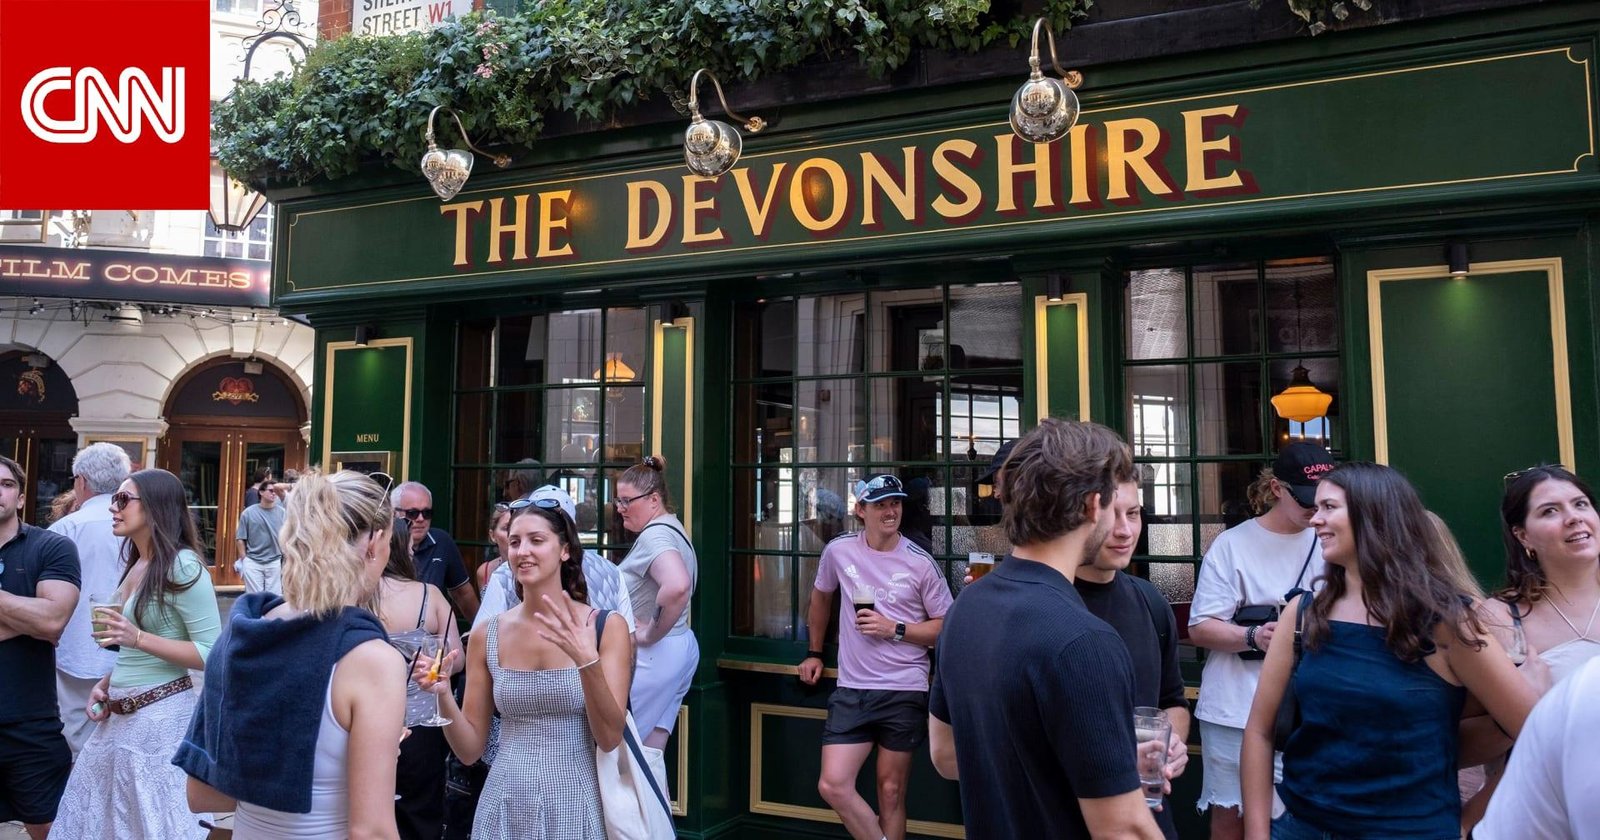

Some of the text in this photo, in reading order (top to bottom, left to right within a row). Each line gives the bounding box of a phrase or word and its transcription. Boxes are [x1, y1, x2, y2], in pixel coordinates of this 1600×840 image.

[362, 6, 421, 35] STREET
[428, 0, 452, 23] W1
[440, 105, 1243, 265] THE DEVONSHIRE
[0, 259, 90, 280] ILM
[104, 263, 251, 289] COMES
[356, 433, 380, 443] MENU
